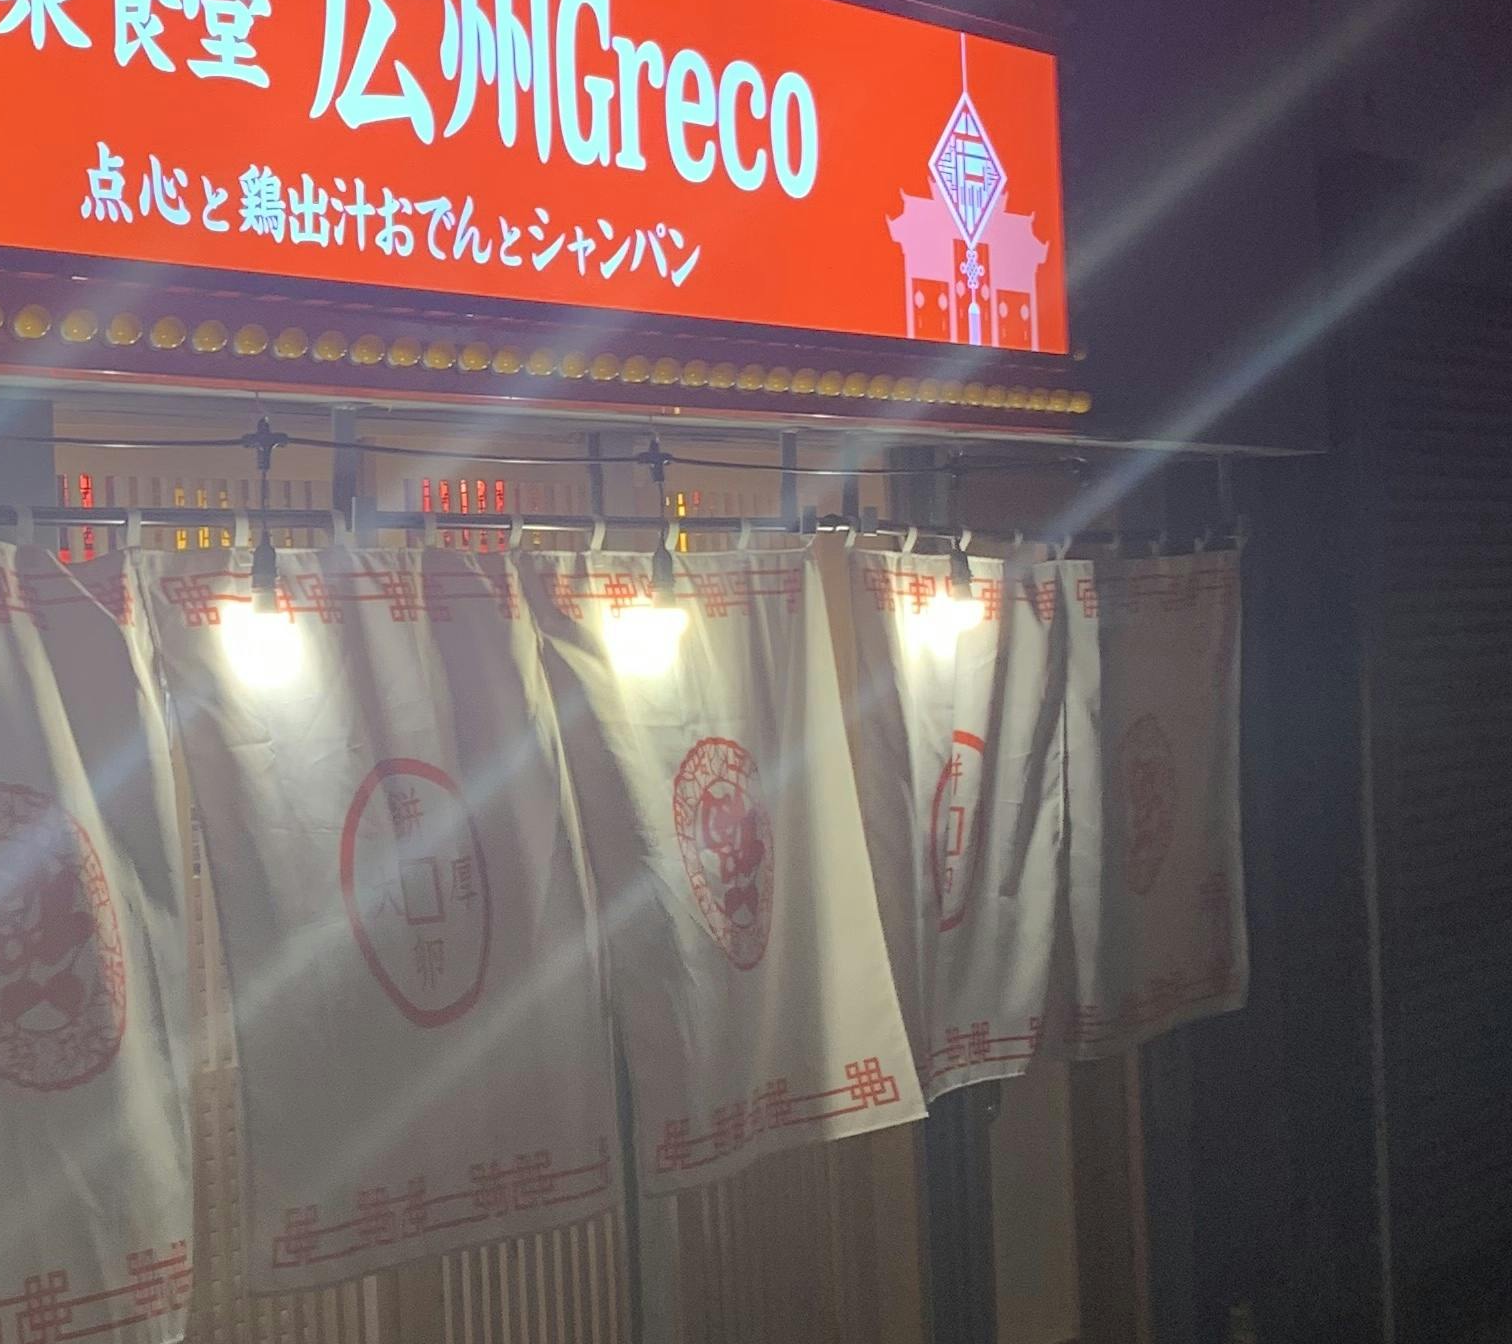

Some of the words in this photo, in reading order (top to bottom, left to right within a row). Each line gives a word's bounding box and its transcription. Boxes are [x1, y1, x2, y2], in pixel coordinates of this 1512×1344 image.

[80, 141, 701, 287] 点心と鶏出汁おでんとシャンパン
